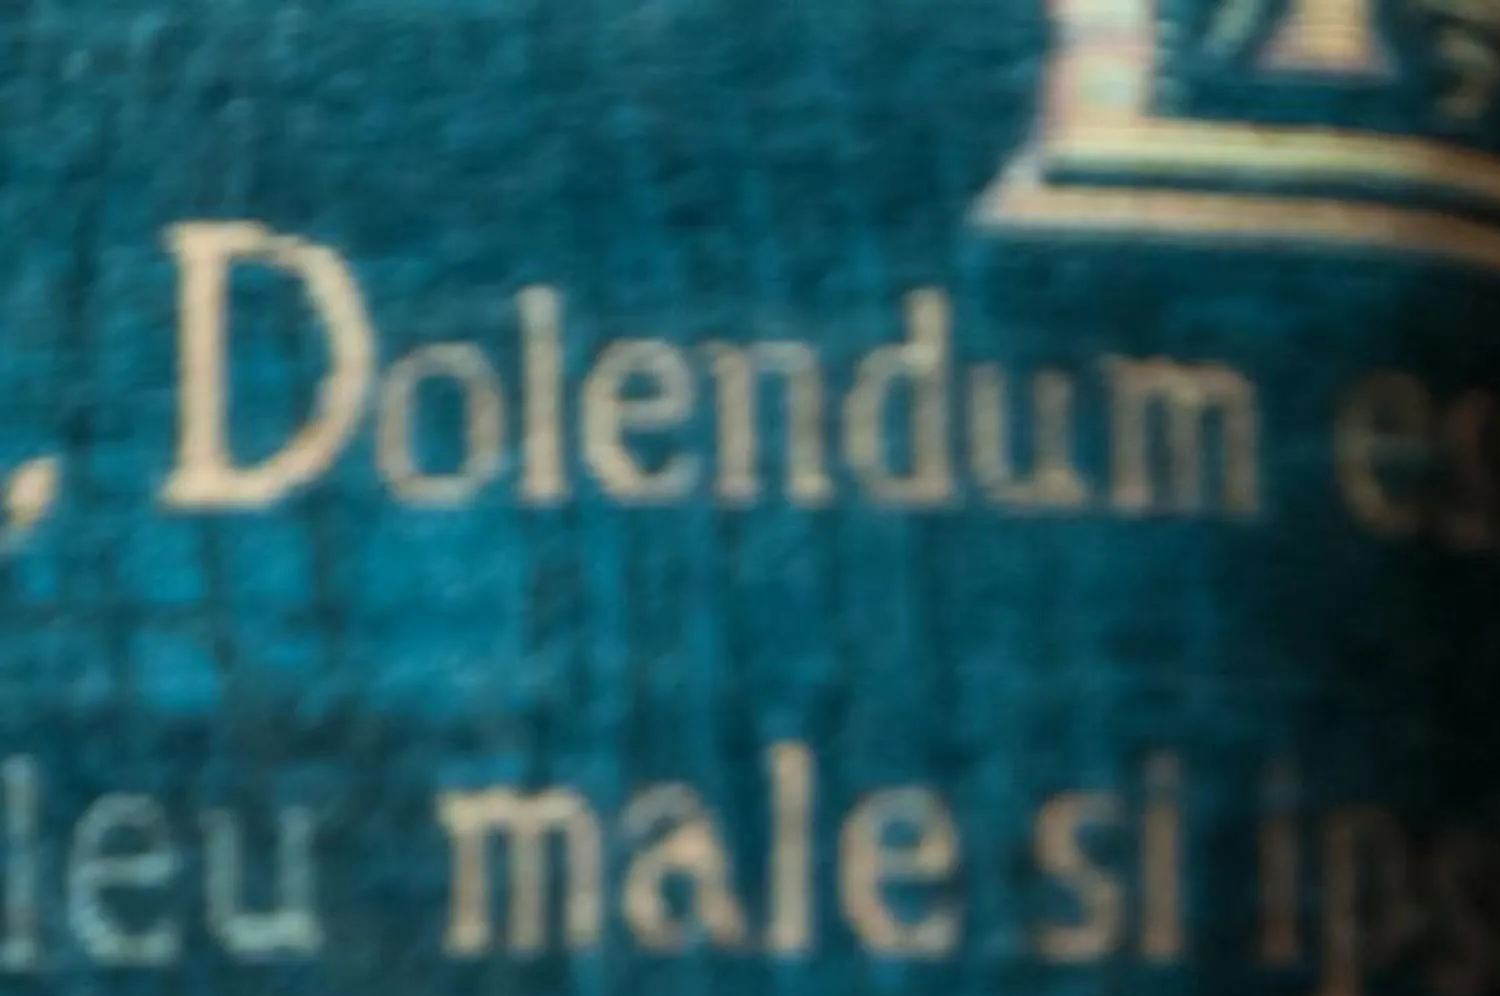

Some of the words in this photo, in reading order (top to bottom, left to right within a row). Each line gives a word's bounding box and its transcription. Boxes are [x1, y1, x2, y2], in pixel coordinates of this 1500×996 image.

[158, 219, 1262, 516] Dolendum
[435, 738, 962, 964] male
[1033, 750, 1186, 965] si
